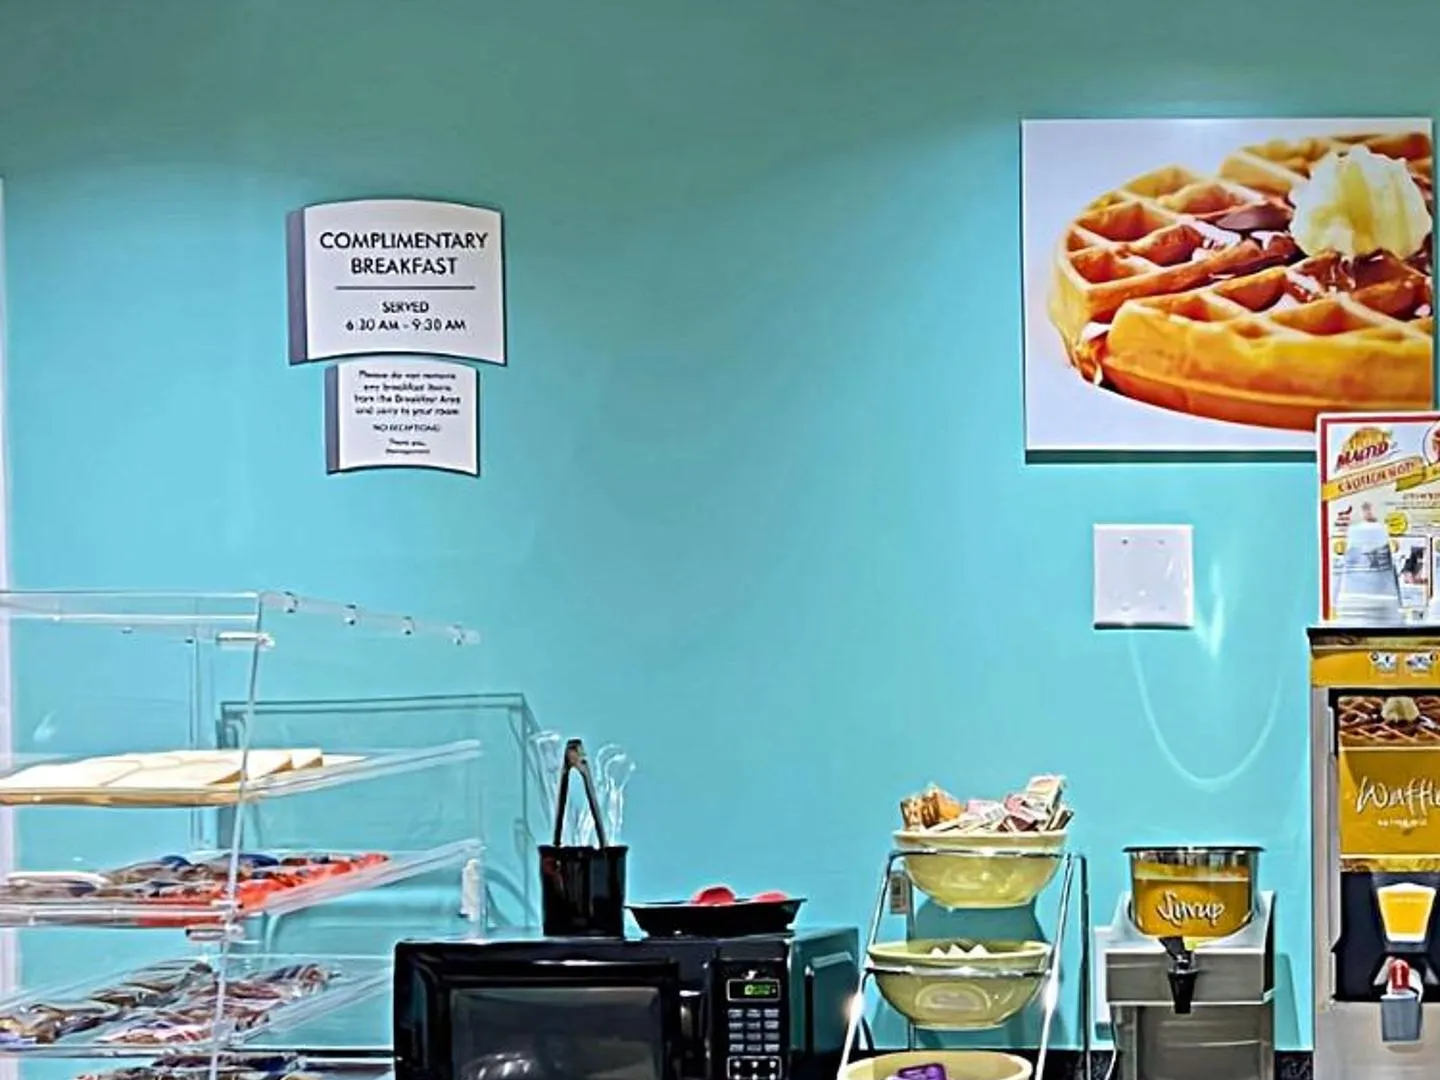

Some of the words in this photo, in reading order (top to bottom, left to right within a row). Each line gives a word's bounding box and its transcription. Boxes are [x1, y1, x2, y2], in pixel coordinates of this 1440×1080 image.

[319, 232, 489, 249] COMPLIMENTARY
[350, 257, 458, 275] BREAKFAST
[381, 300, 430, 314] SERVED
[379, 319, 399, 331] AM
[444, 319, 466, 331] AM
[1156, 889, 1226, 928] Syrup
